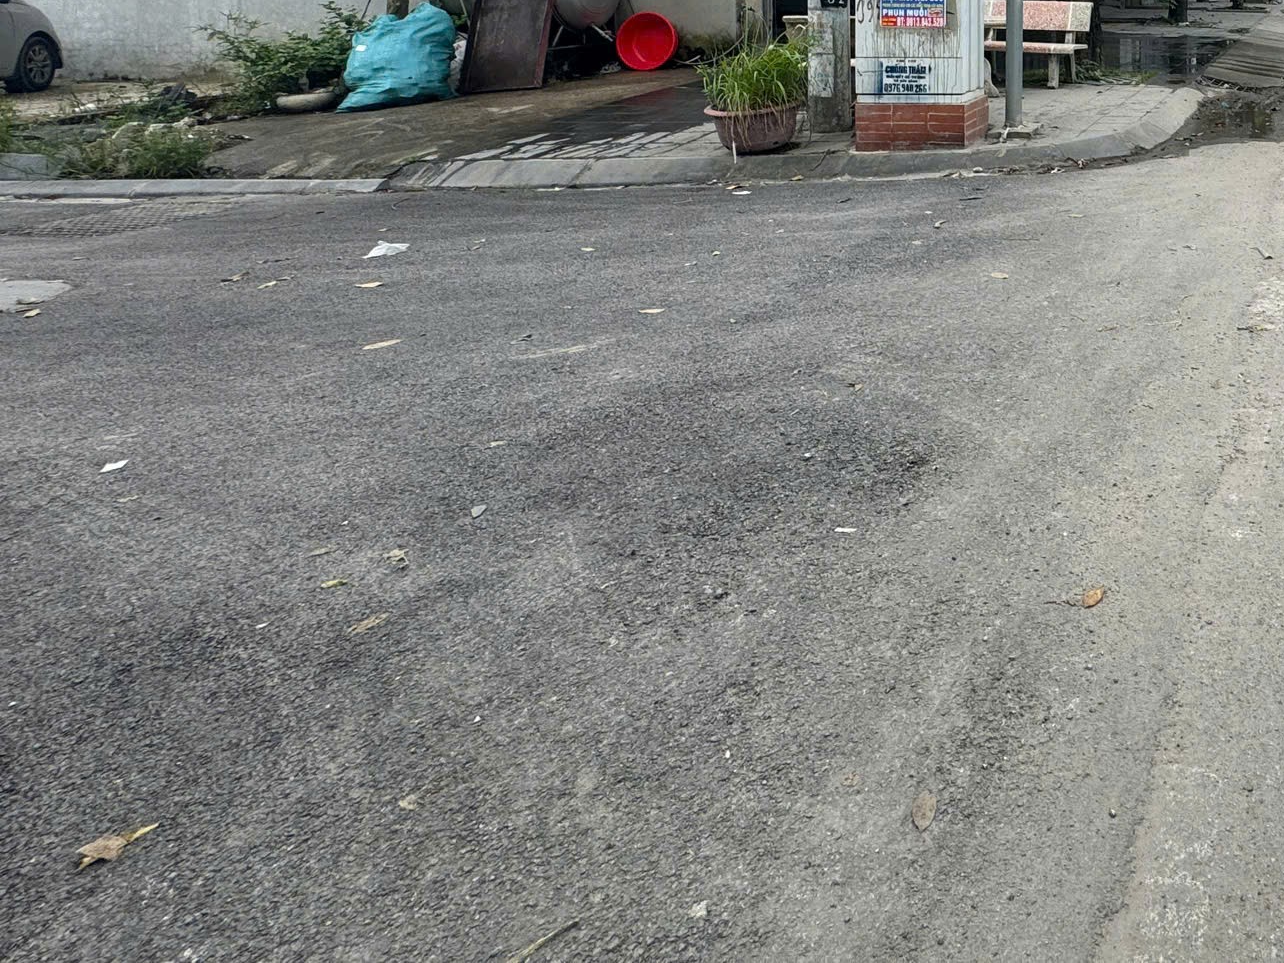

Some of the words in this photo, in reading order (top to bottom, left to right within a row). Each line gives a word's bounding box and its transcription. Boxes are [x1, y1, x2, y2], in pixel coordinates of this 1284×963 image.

[882, 8, 904, 17] PHUN
[885, 64, 908, 74] CHỐNG
[884, 84, 900, 93] 0976
